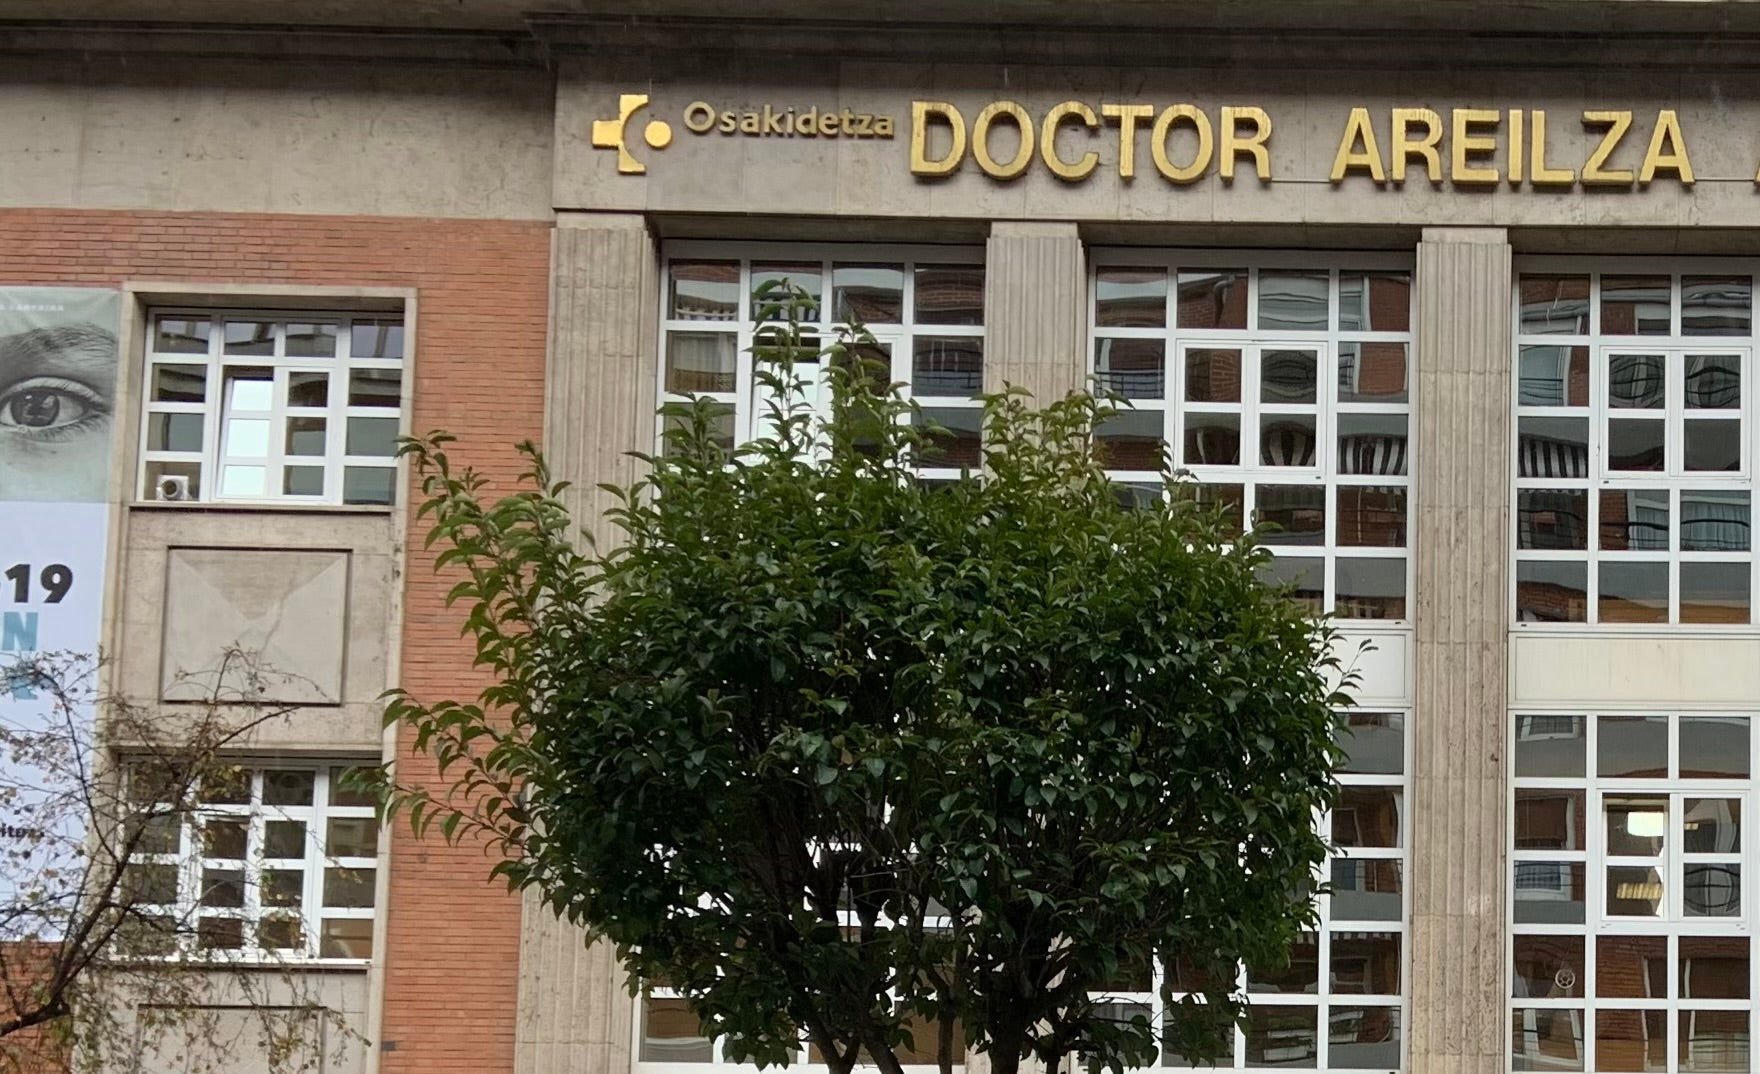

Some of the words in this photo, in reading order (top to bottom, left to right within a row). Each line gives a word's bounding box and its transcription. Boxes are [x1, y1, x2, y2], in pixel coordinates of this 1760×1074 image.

[683, 100, 895, 140] Osakidetza
[911, 100, 1273, 184] DOCTOR
[1329, 107, 1696, 186] AREILZA
